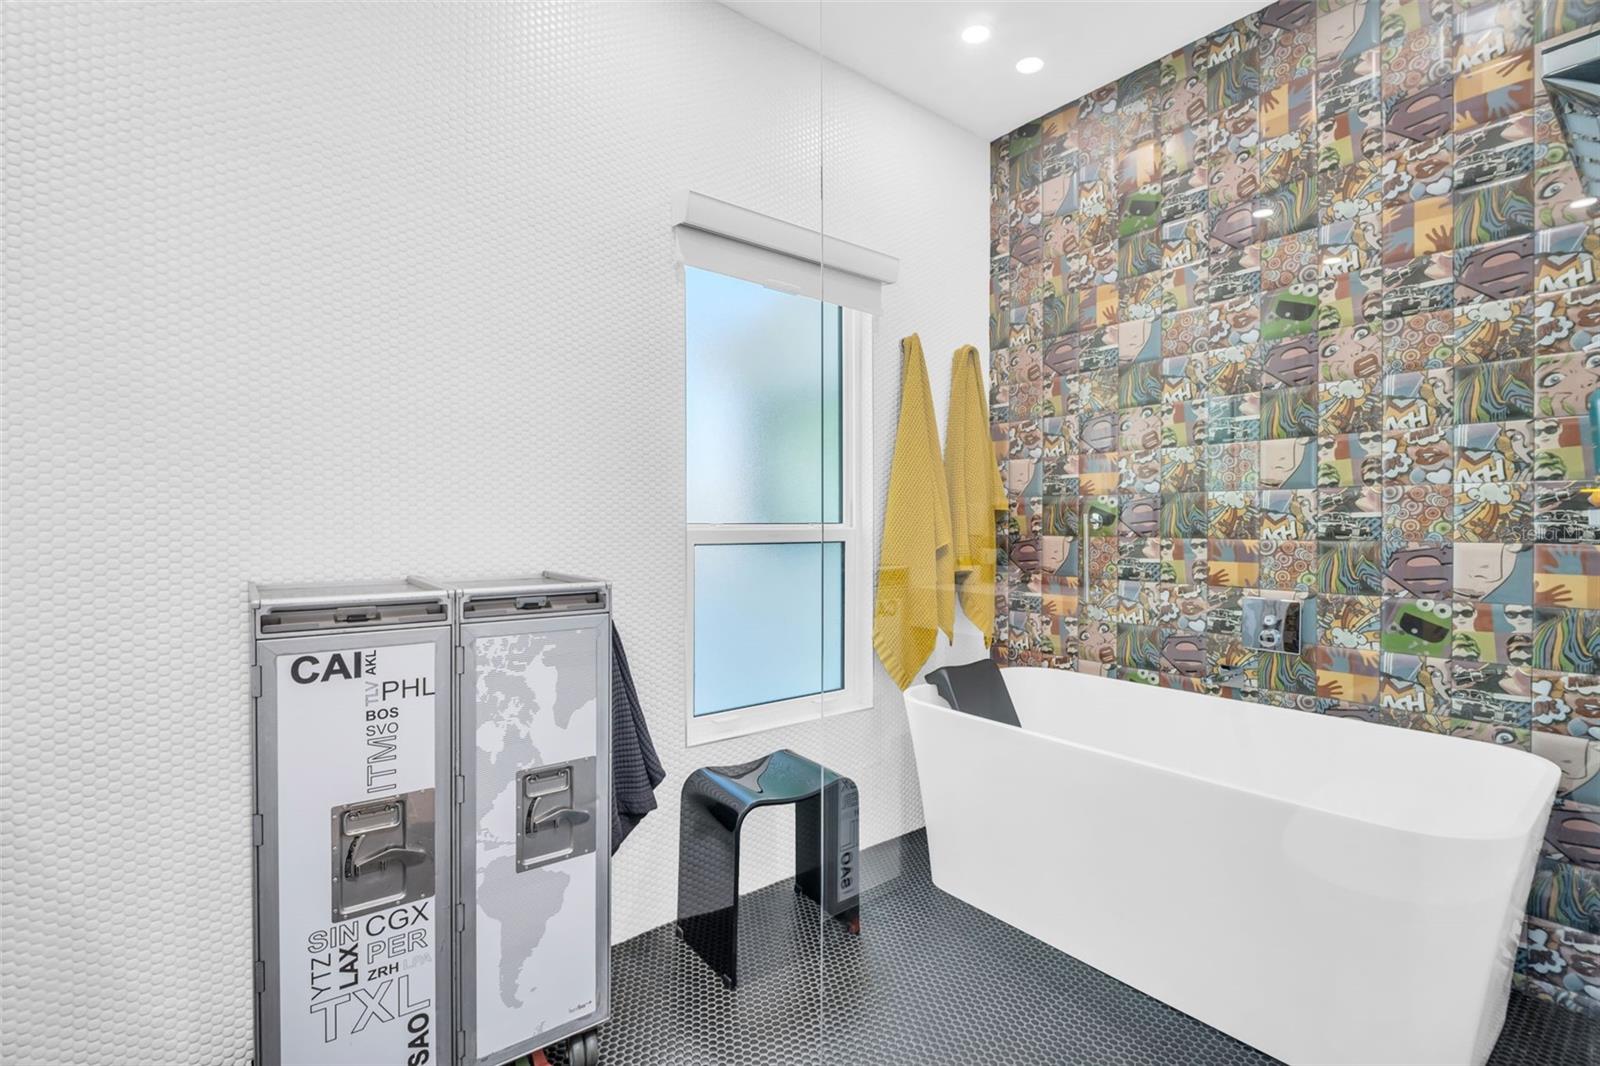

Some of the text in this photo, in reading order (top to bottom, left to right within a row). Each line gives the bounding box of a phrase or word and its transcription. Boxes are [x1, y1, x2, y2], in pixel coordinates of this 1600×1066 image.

[290, 651, 362, 685] CAI
[365, 650, 377, 676] AKL
[365, 681, 379, 707] TLV
[382, 677, 436, 701] PHL
[366, 707, 399, 721] BOS
[366, 722, 399, 737] SVO
[367, 735, 397, 794] ITM
[366, 902, 429, 937] CGX
[307, 920, 359, 954] SIN
[367, 928, 428, 965] PER
[311, 953, 331, 1001] YTZ
[339, 943, 359, 990] LAX
[367, 962, 400, 982] ZRH
[310, 974, 431, 1043] TXL
[408, 1013, 430, 1066] SAO
